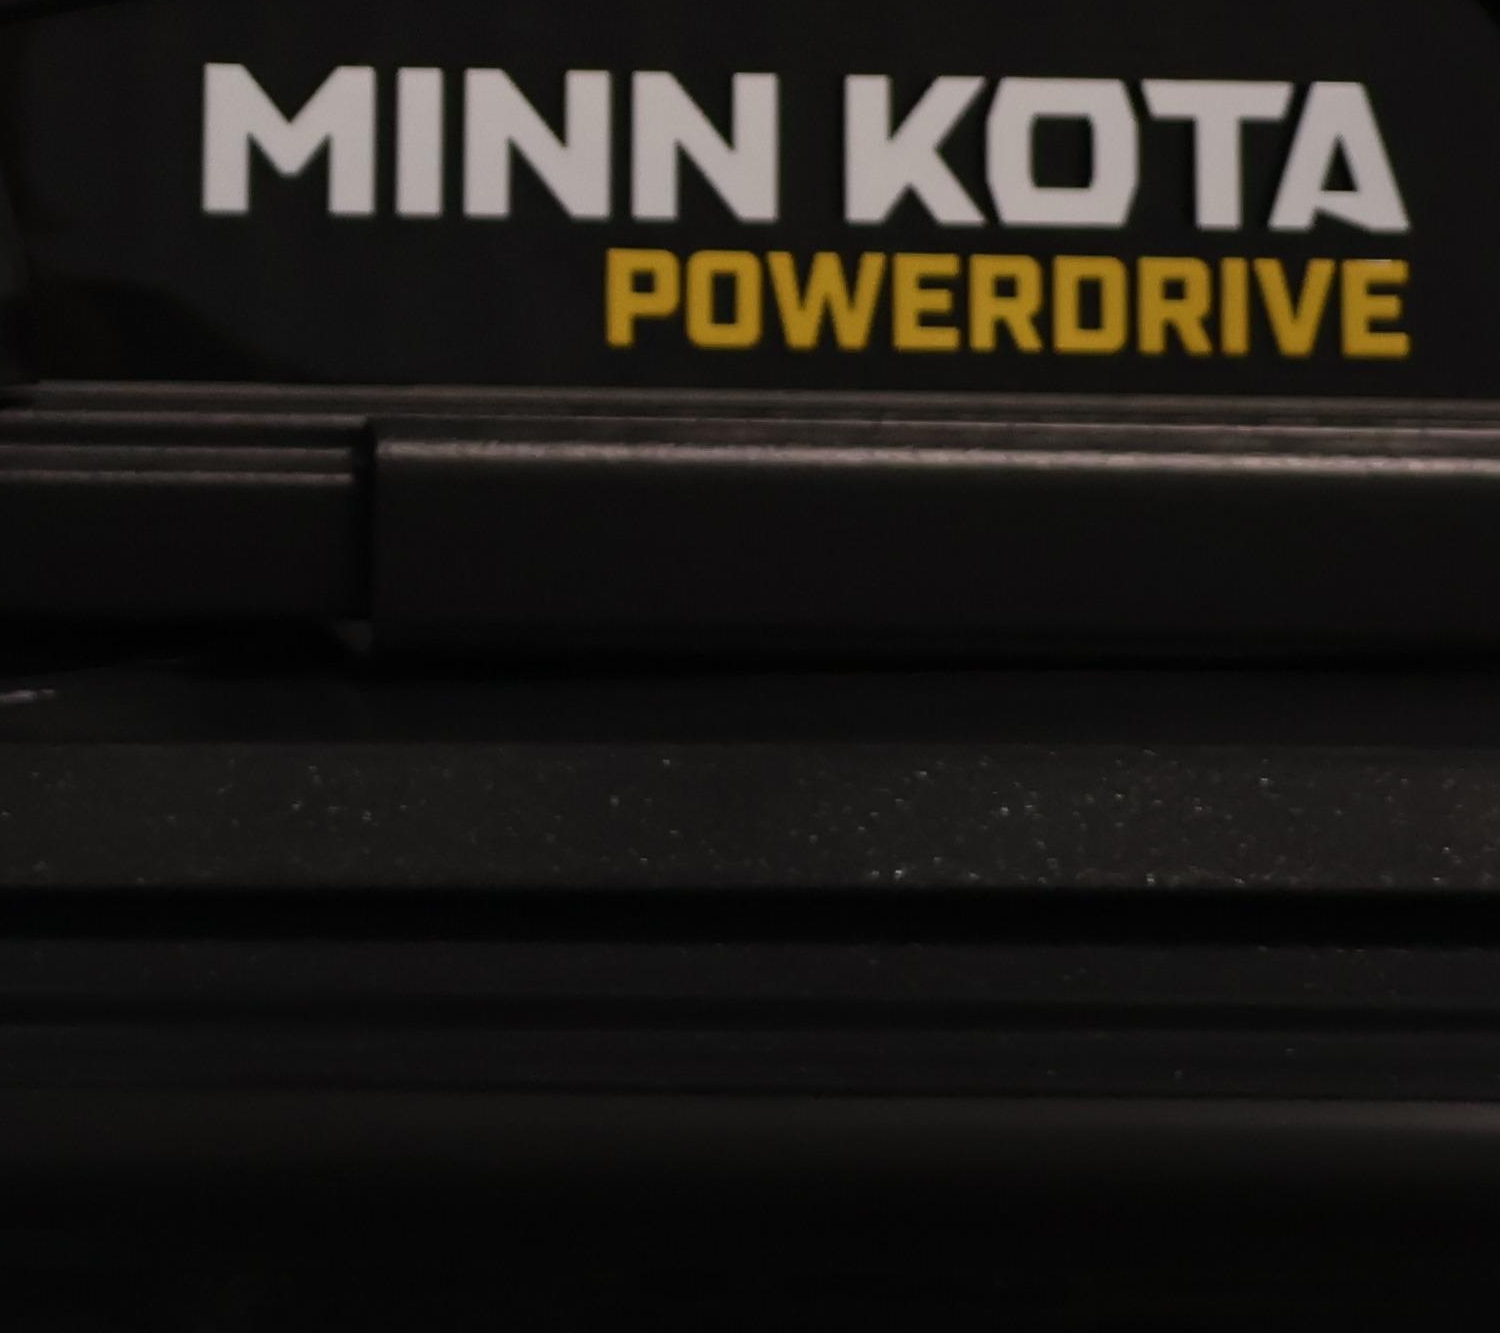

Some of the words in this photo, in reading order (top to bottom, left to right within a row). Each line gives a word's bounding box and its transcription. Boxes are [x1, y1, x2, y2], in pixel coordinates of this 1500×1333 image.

[202, 62, 778, 221] MINN
[845, 74, 1410, 231] KOTA
[606, 247, 1410, 357] POWERDRIVE
